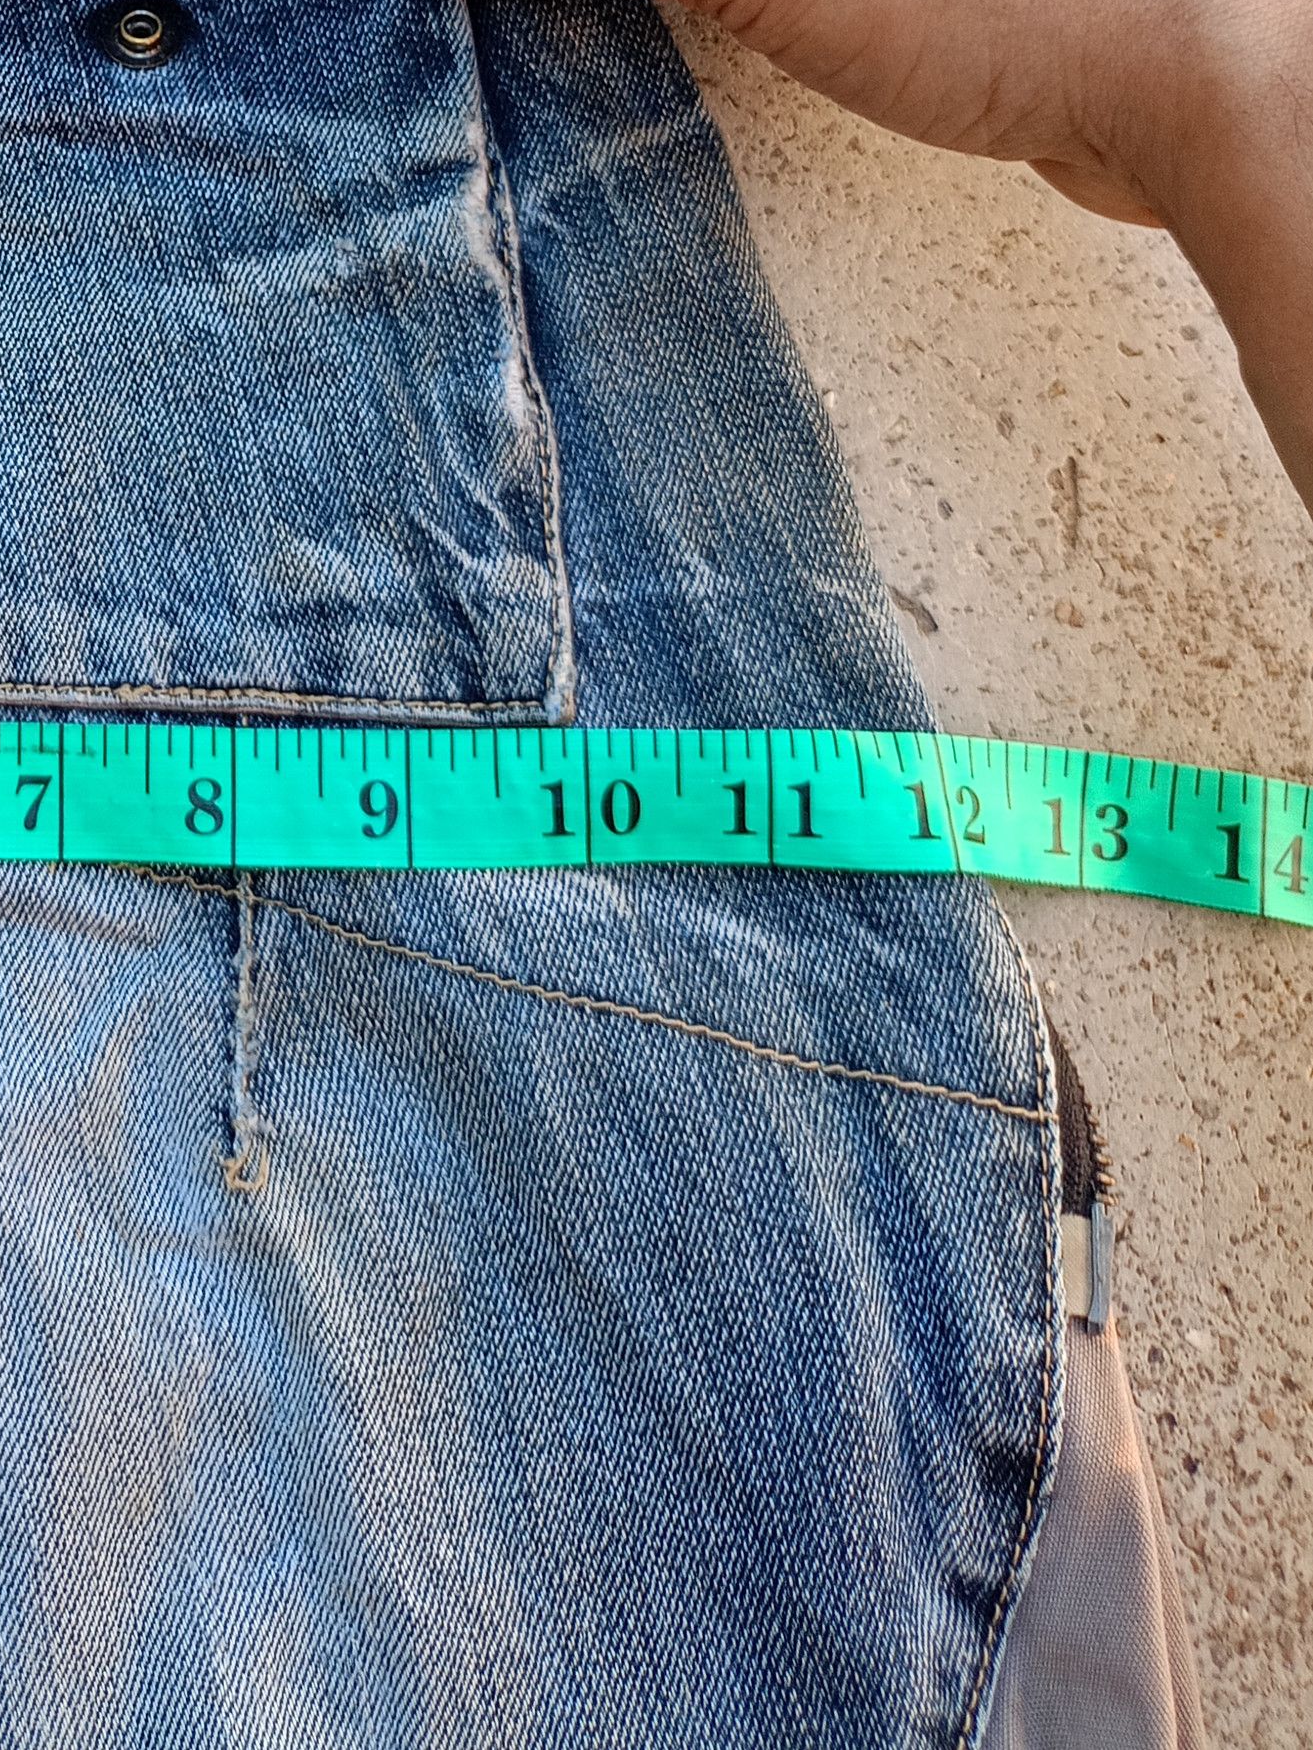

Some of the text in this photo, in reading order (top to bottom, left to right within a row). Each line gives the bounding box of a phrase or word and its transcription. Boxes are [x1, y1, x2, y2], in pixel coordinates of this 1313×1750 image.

[16, 775, 53, 831] 7
[186, 778, 224, 835] 8
[360, 780, 399, 838] 9
